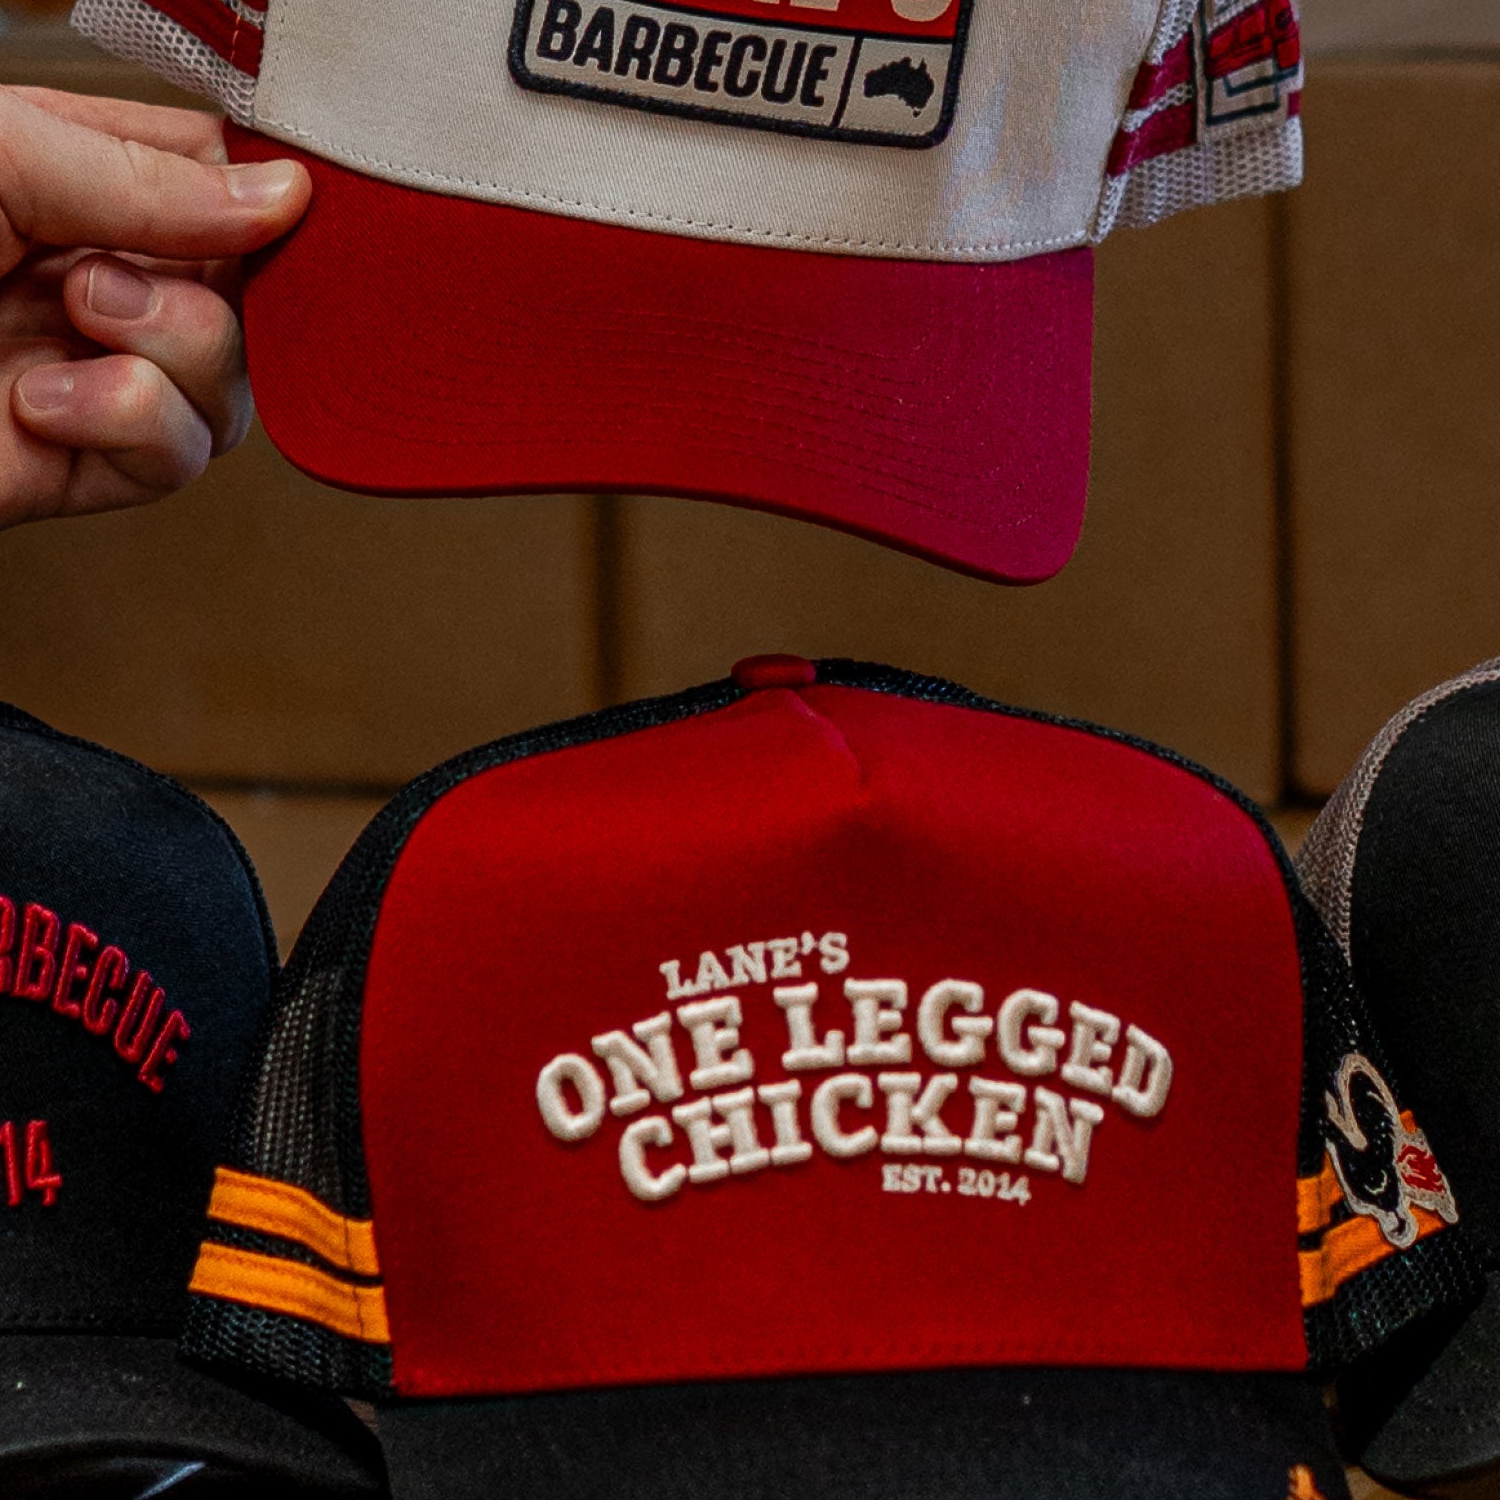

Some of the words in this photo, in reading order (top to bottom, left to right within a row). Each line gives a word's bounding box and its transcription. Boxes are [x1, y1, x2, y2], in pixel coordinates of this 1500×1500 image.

[658, 931, 851, 1000] LANE'S
[535, 994, 756, 1142] ONE
[771, 976, 1175, 1118] LEGGED
[617, 1070, 1105, 1202] CHICKEN
[956, 1165, 1033, 1206] 2014
